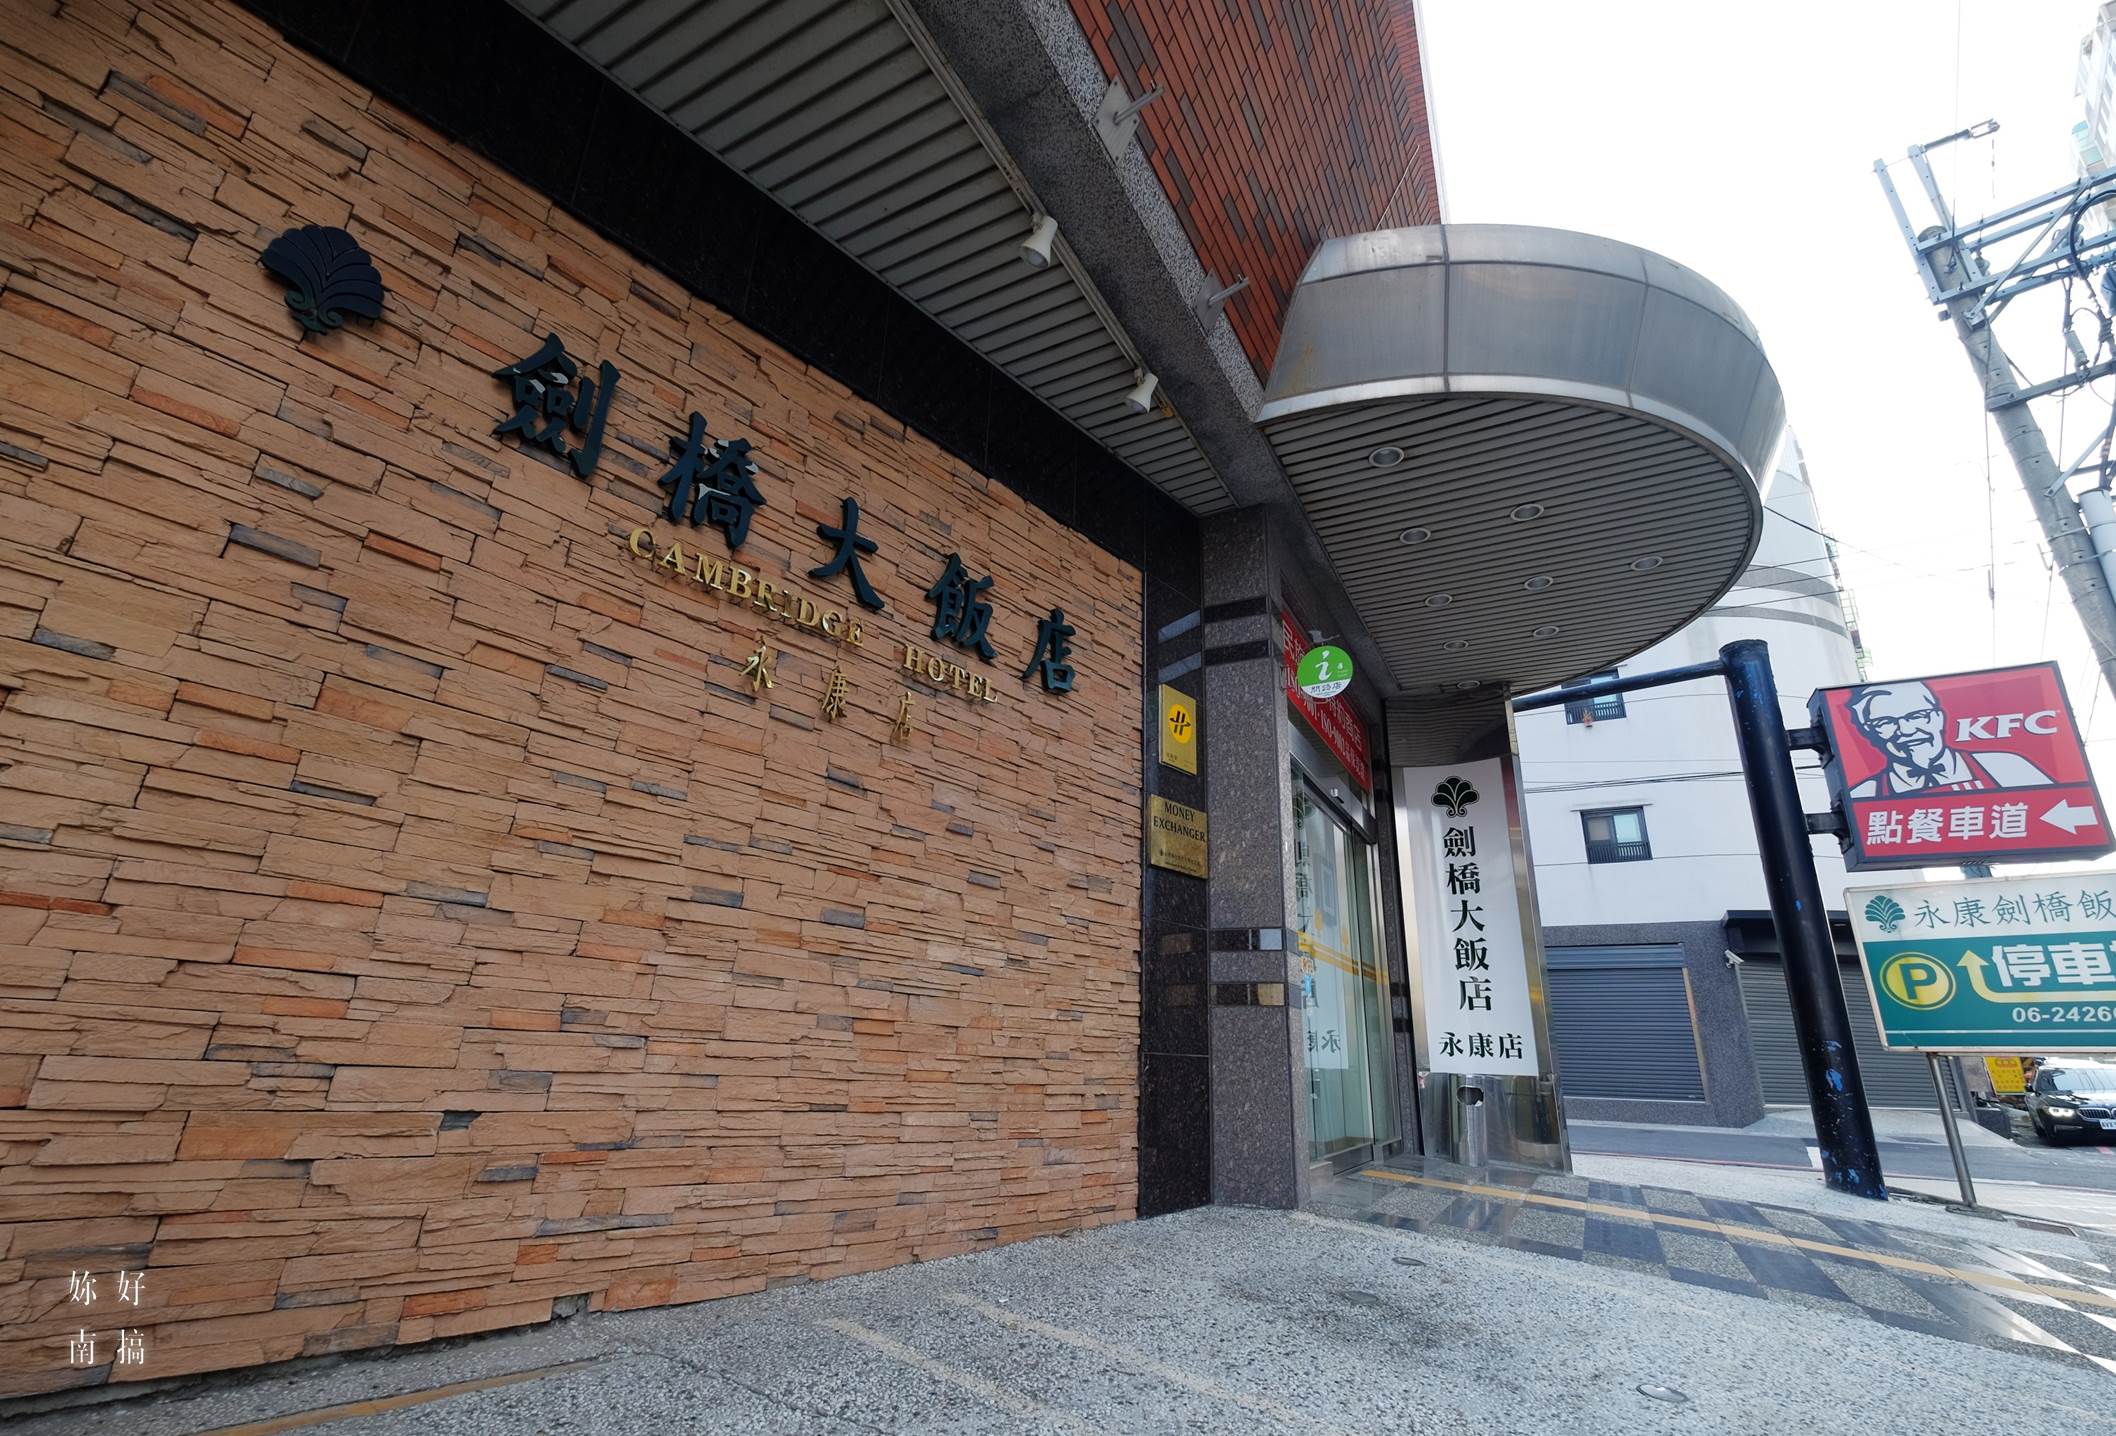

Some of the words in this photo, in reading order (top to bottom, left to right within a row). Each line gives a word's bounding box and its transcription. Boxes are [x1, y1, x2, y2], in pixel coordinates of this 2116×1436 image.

[493, 332, 1079, 694] 劍橋大飯店
[628, 526, 865, 648] CAMBRIDGE
[903, 643, 999, 703] HOTEL
[738, 635, 914, 741] 永康店
[1954, 710, 2059, 742] KFC
[1153, 815, 1206, 843] EXCHANGER
[1164, 801, 1195, 822] MONEY
[1866, 803, 2029, 846] 點餐車道
[1443, 826, 1493, 1012] 劍橋大飯店
[1914, 889, 2116, 929] 永康劍橋飯
[1992, 941, 2116, 987] 停車
[2012, 1005, 2116, 1023] 06-2426
[1438, 1031, 1523, 1060] 永康店
